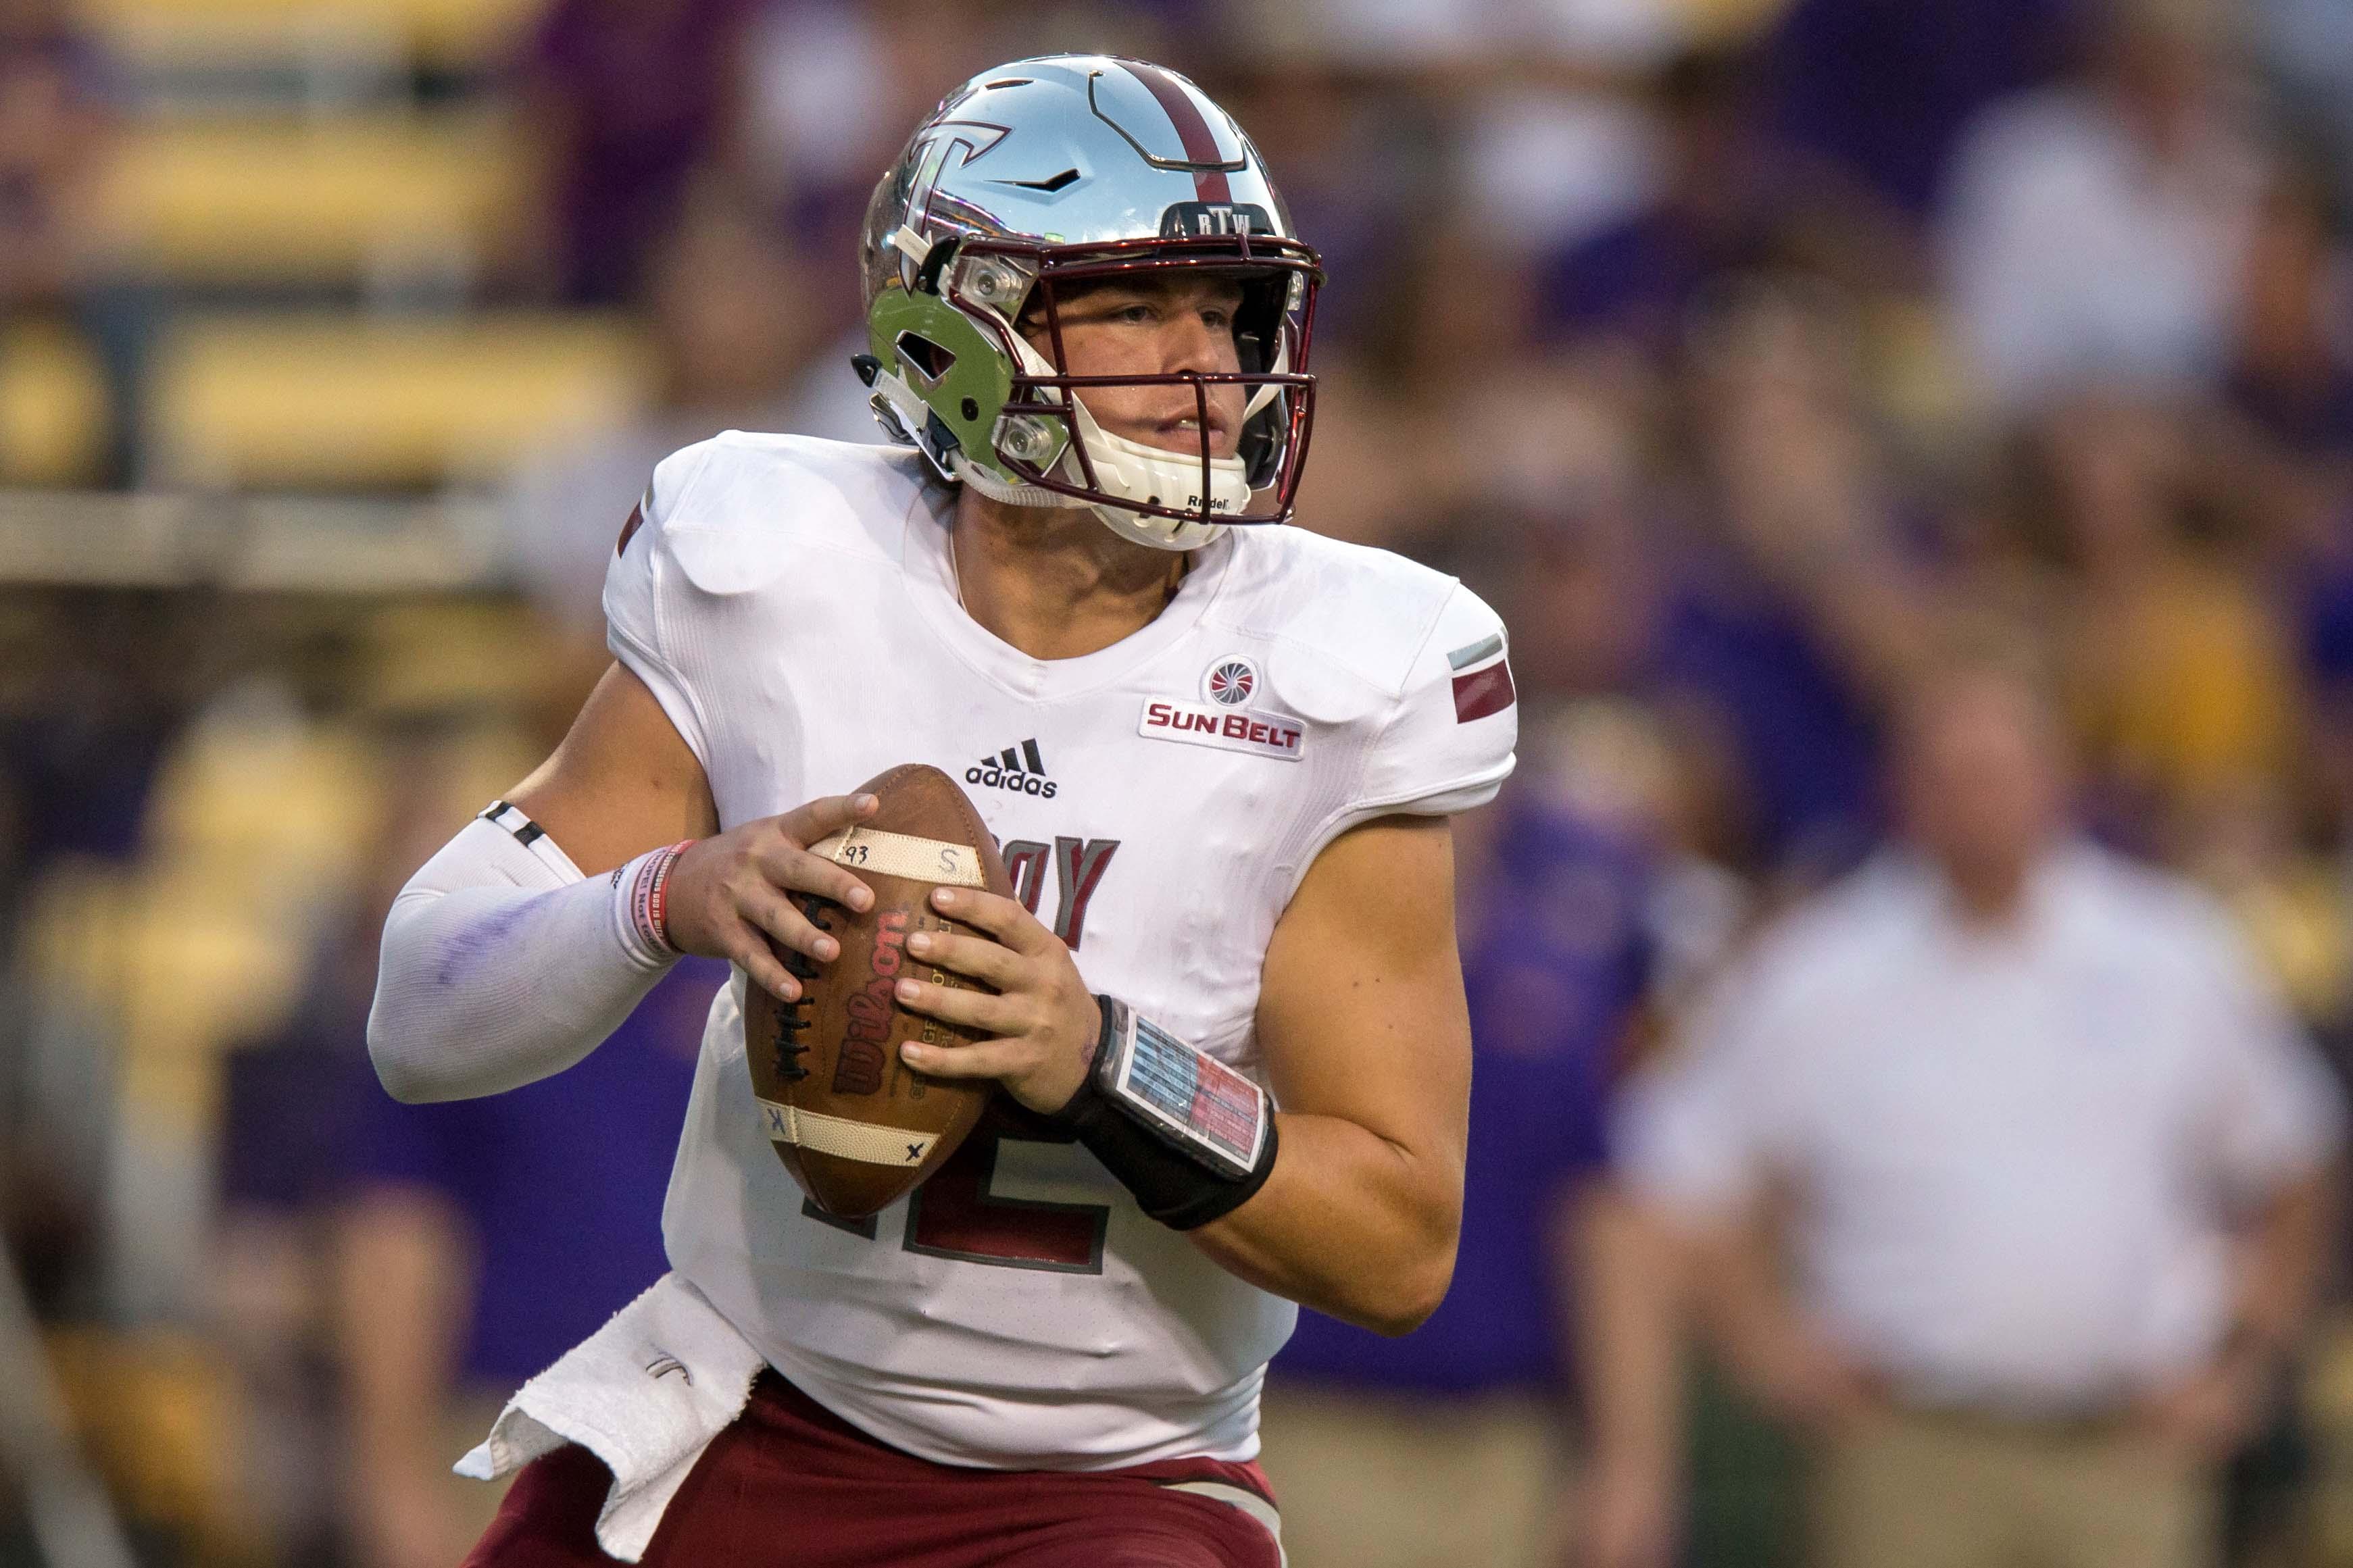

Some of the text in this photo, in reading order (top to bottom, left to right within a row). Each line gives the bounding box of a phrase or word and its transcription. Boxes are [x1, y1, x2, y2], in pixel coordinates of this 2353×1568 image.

[1197, 205, 1250, 235] RTW
[966, 766, 1058, 799] adidas
[845, 846, 868, 865] 93
[939, 849, 960, 874] S
[652, 893, 660, 909] GOD
[652, 910, 660, 919] IS
[832, 911, 909, 1096] Wilson
